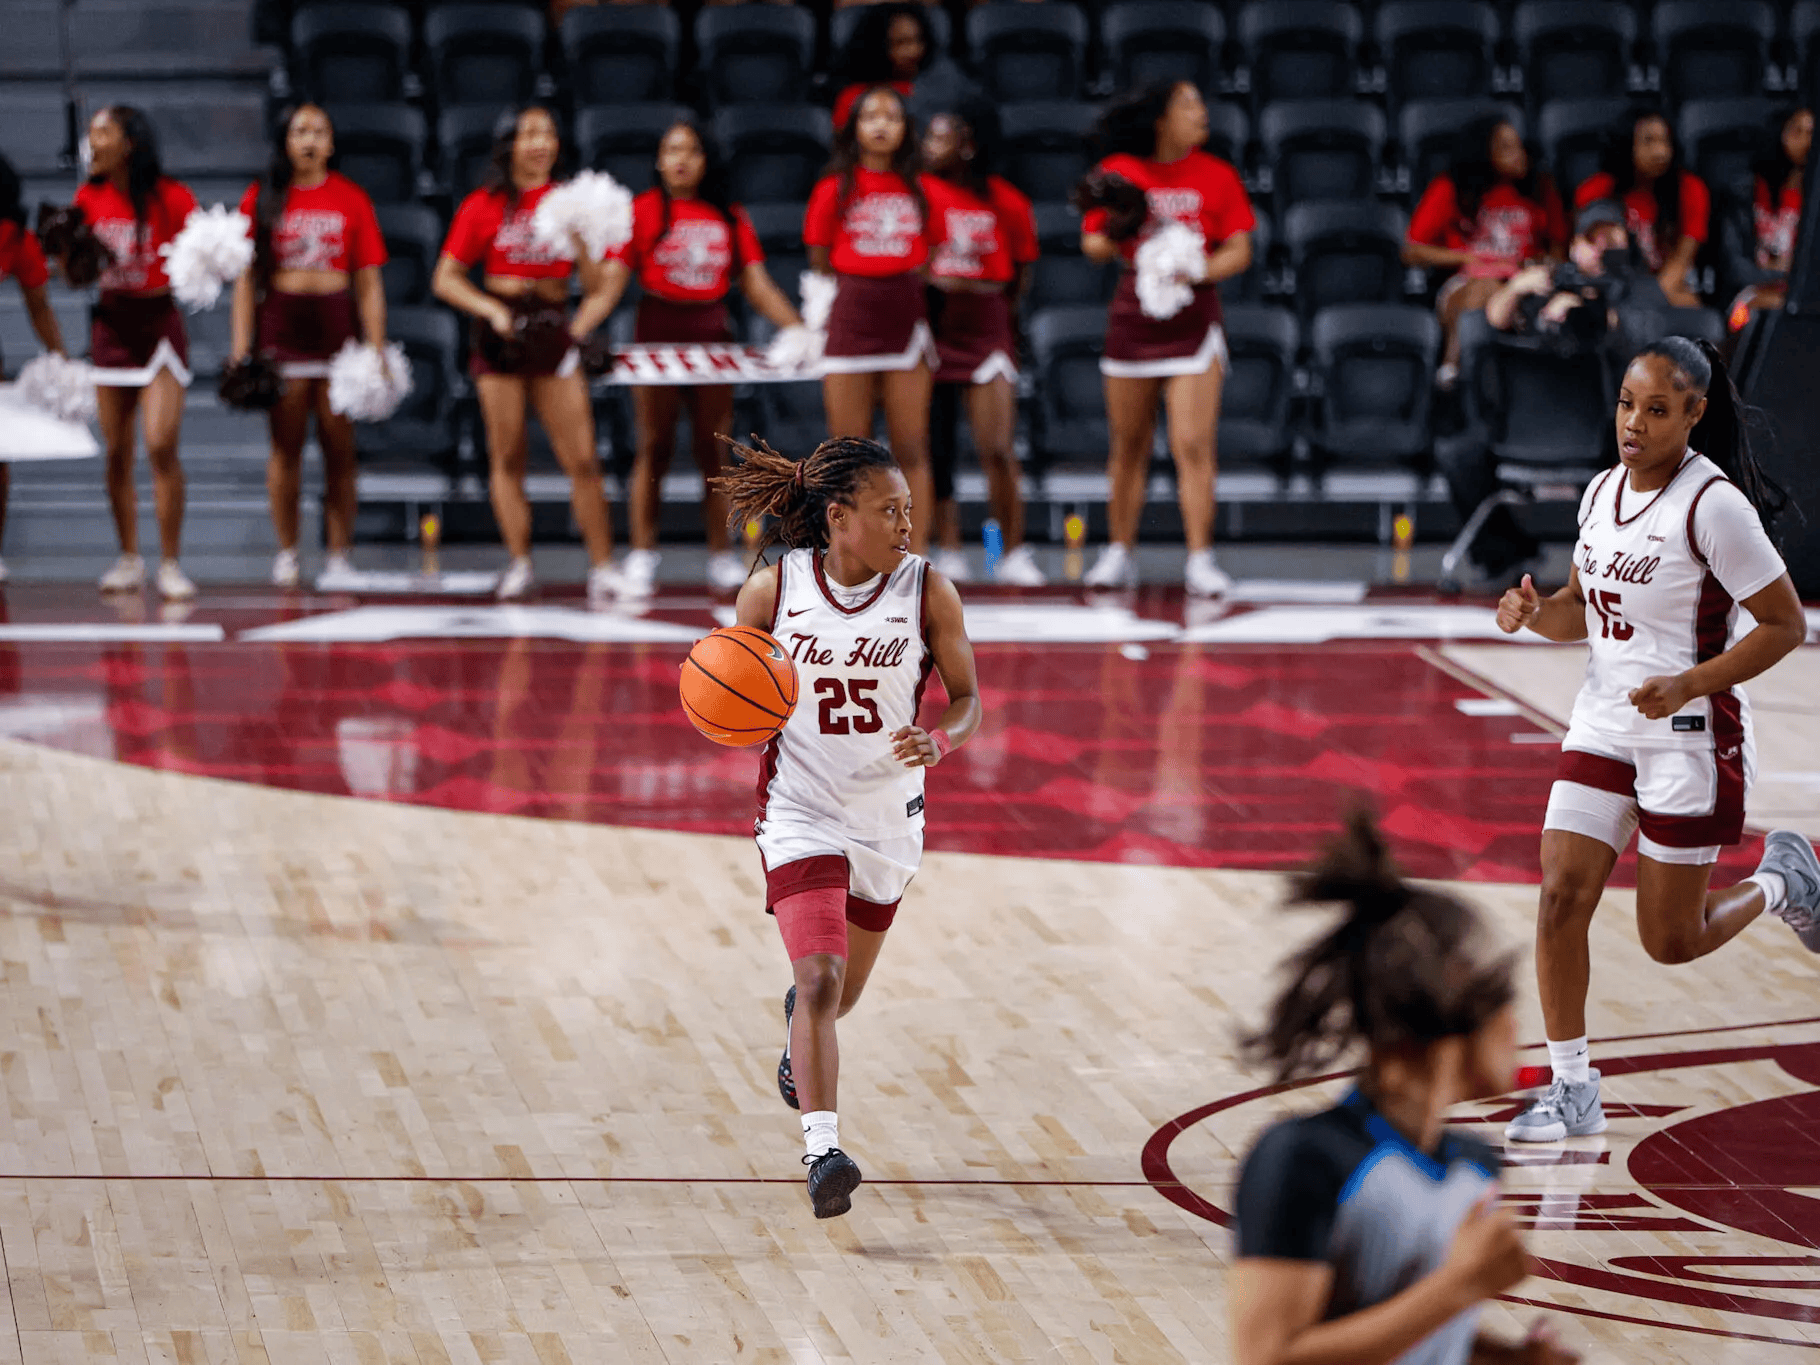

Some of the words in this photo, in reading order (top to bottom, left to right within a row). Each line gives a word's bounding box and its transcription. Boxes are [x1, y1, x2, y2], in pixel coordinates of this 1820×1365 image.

[1602, 551, 1661, 585] Hill
[890, 616, 908, 624] SWAC
[1588, 588, 1635, 641] 15
[790, 632, 834, 665] The
[844, 636, 909, 667] Hill
[813, 677, 883, 735] 25
